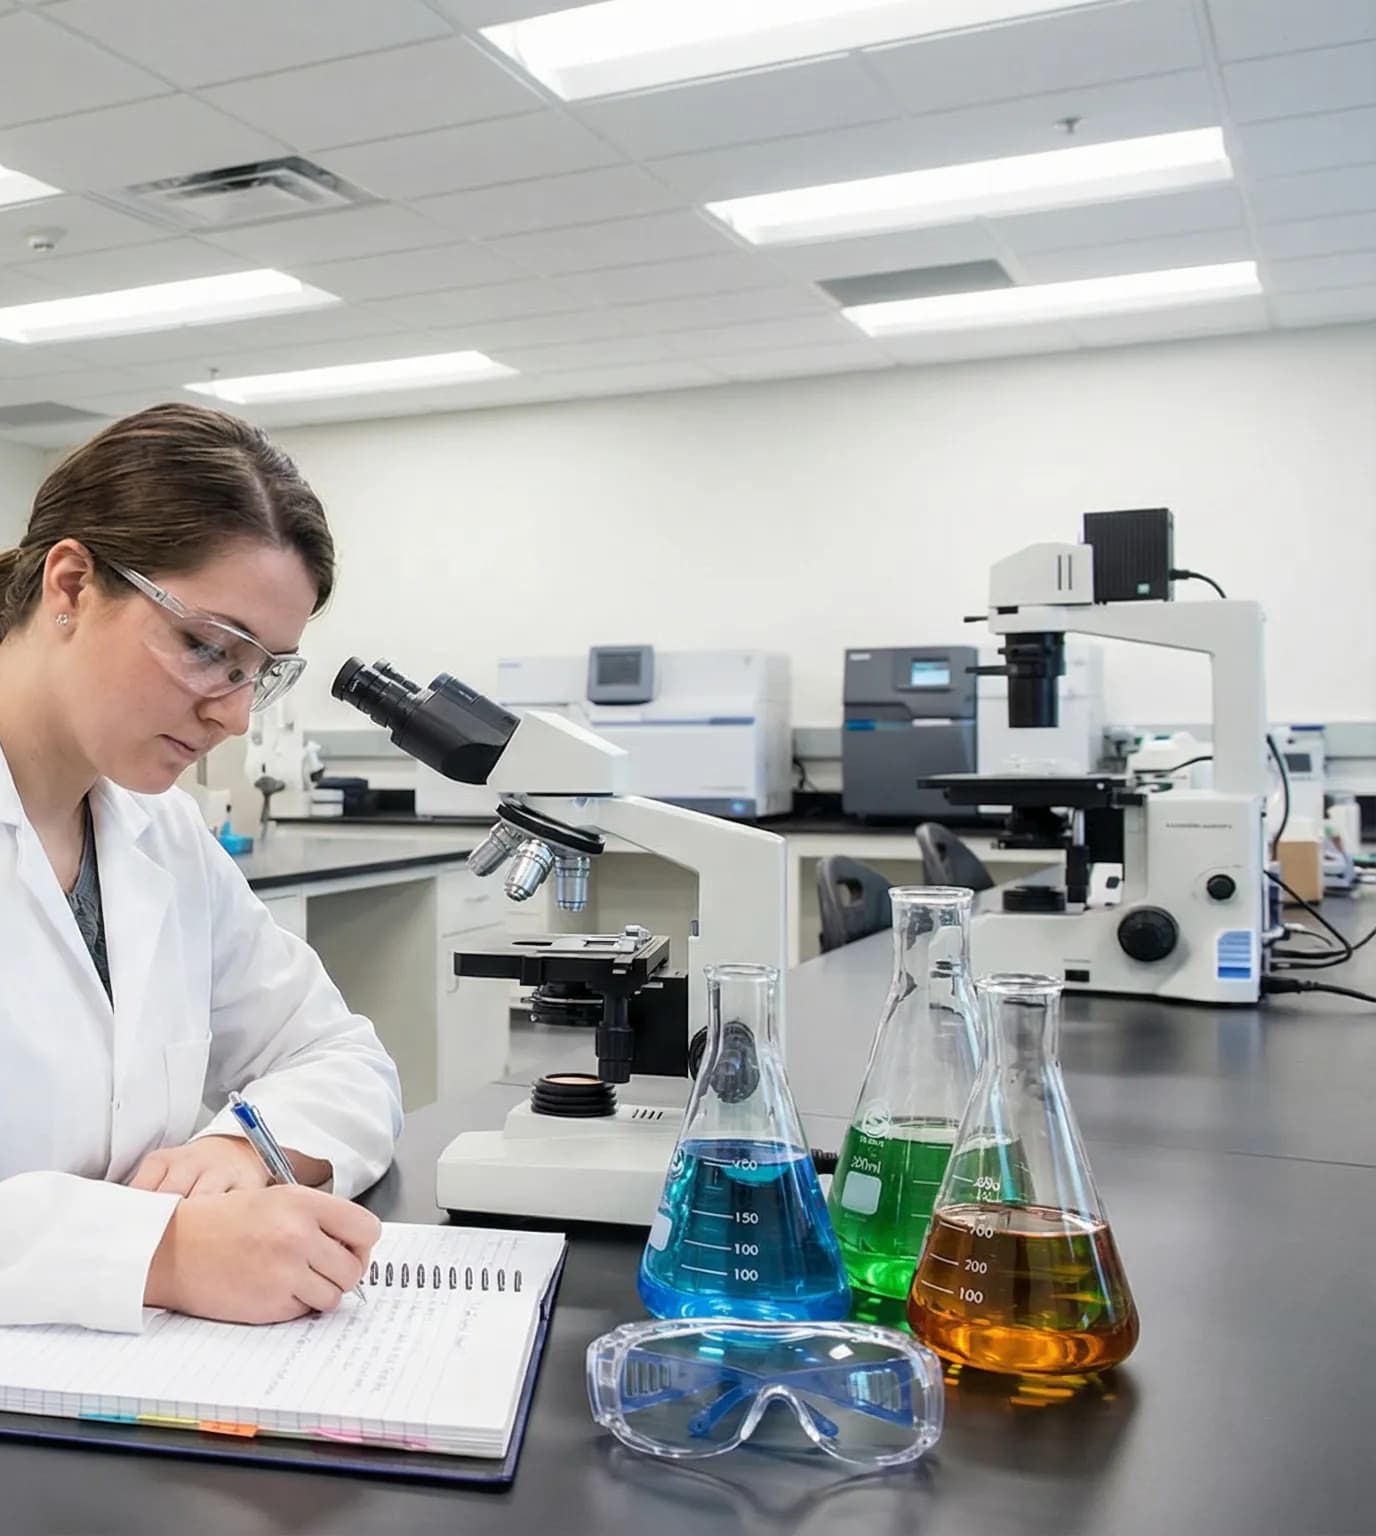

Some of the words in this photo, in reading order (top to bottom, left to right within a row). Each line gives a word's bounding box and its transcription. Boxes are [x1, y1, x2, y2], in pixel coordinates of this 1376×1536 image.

[735, 1211, 759, 1224] 150
[734, 1243, 759, 1256] 100
[964, 1259, 988, 1274] 200
[734, 1268, 759, 1281] 100
[959, 1287, 984, 1304] 100
